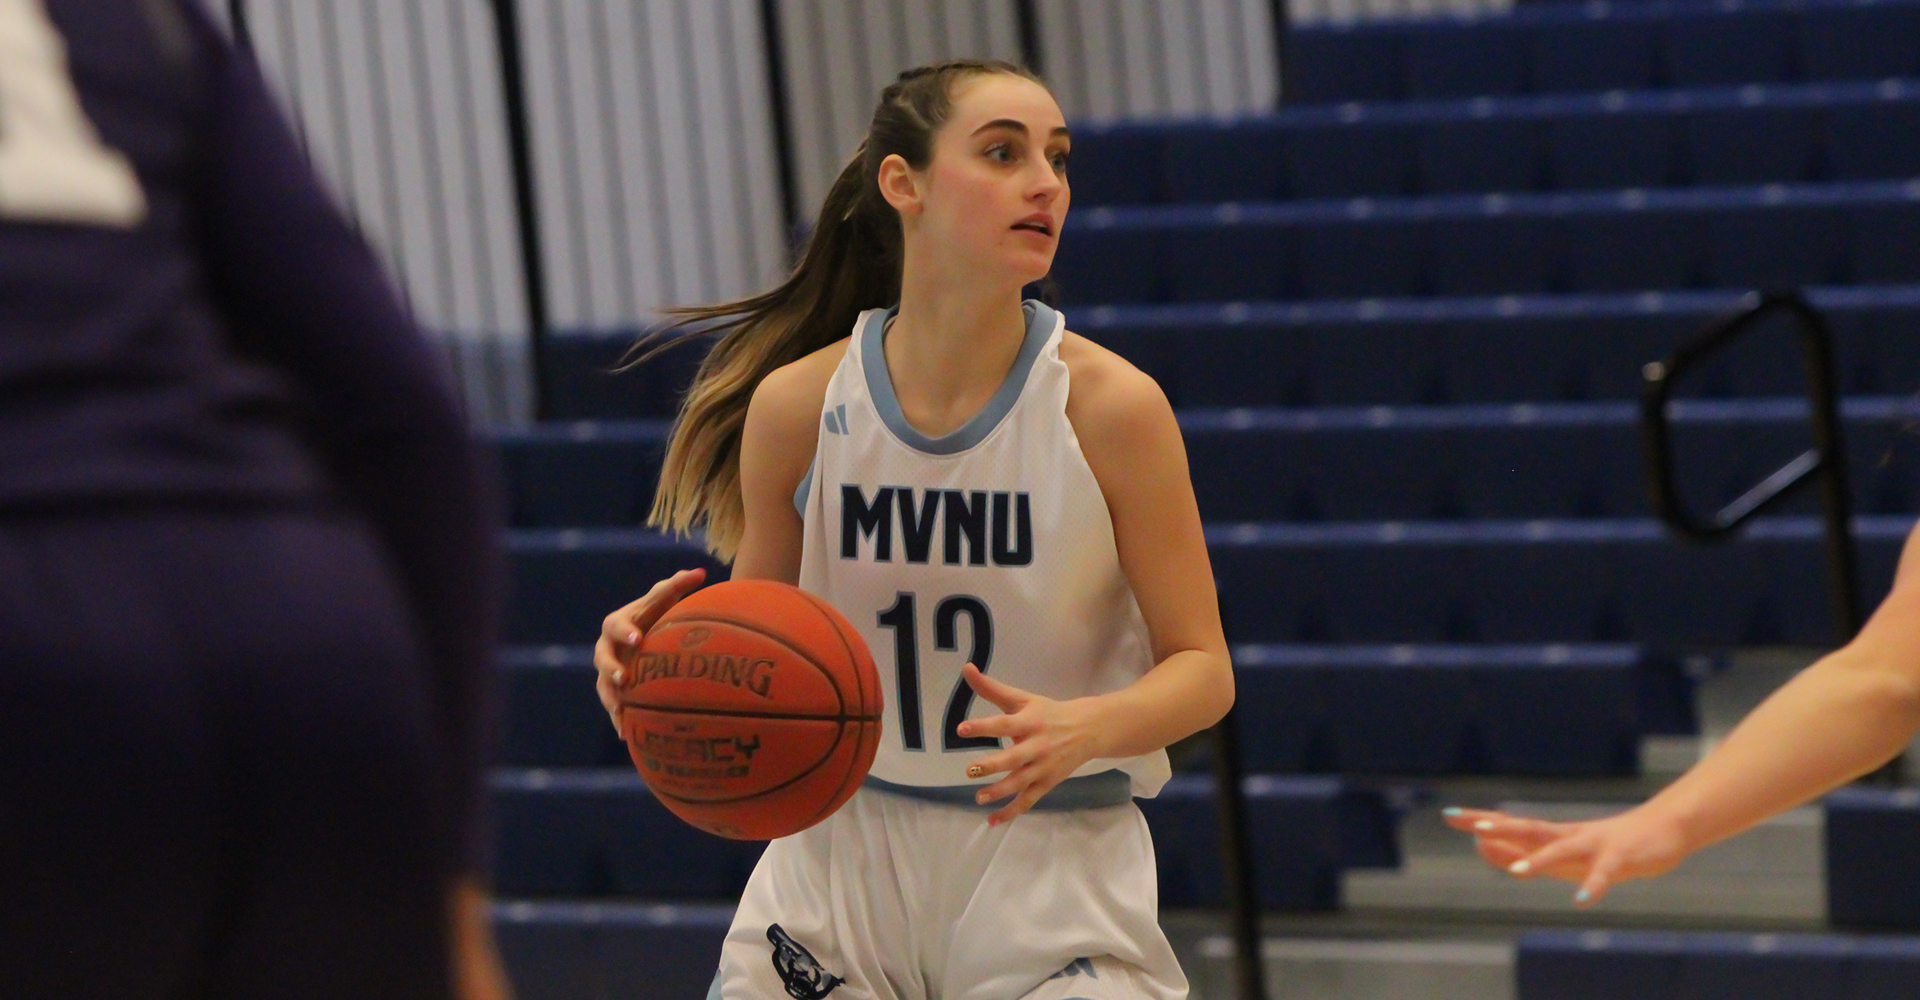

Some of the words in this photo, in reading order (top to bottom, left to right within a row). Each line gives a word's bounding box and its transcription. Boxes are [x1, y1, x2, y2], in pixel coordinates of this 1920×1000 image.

[840, 483, 1034, 568] MVNU
[630, 651, 776, 697] SPALDING
[876, 591, 1004, 753] 12
